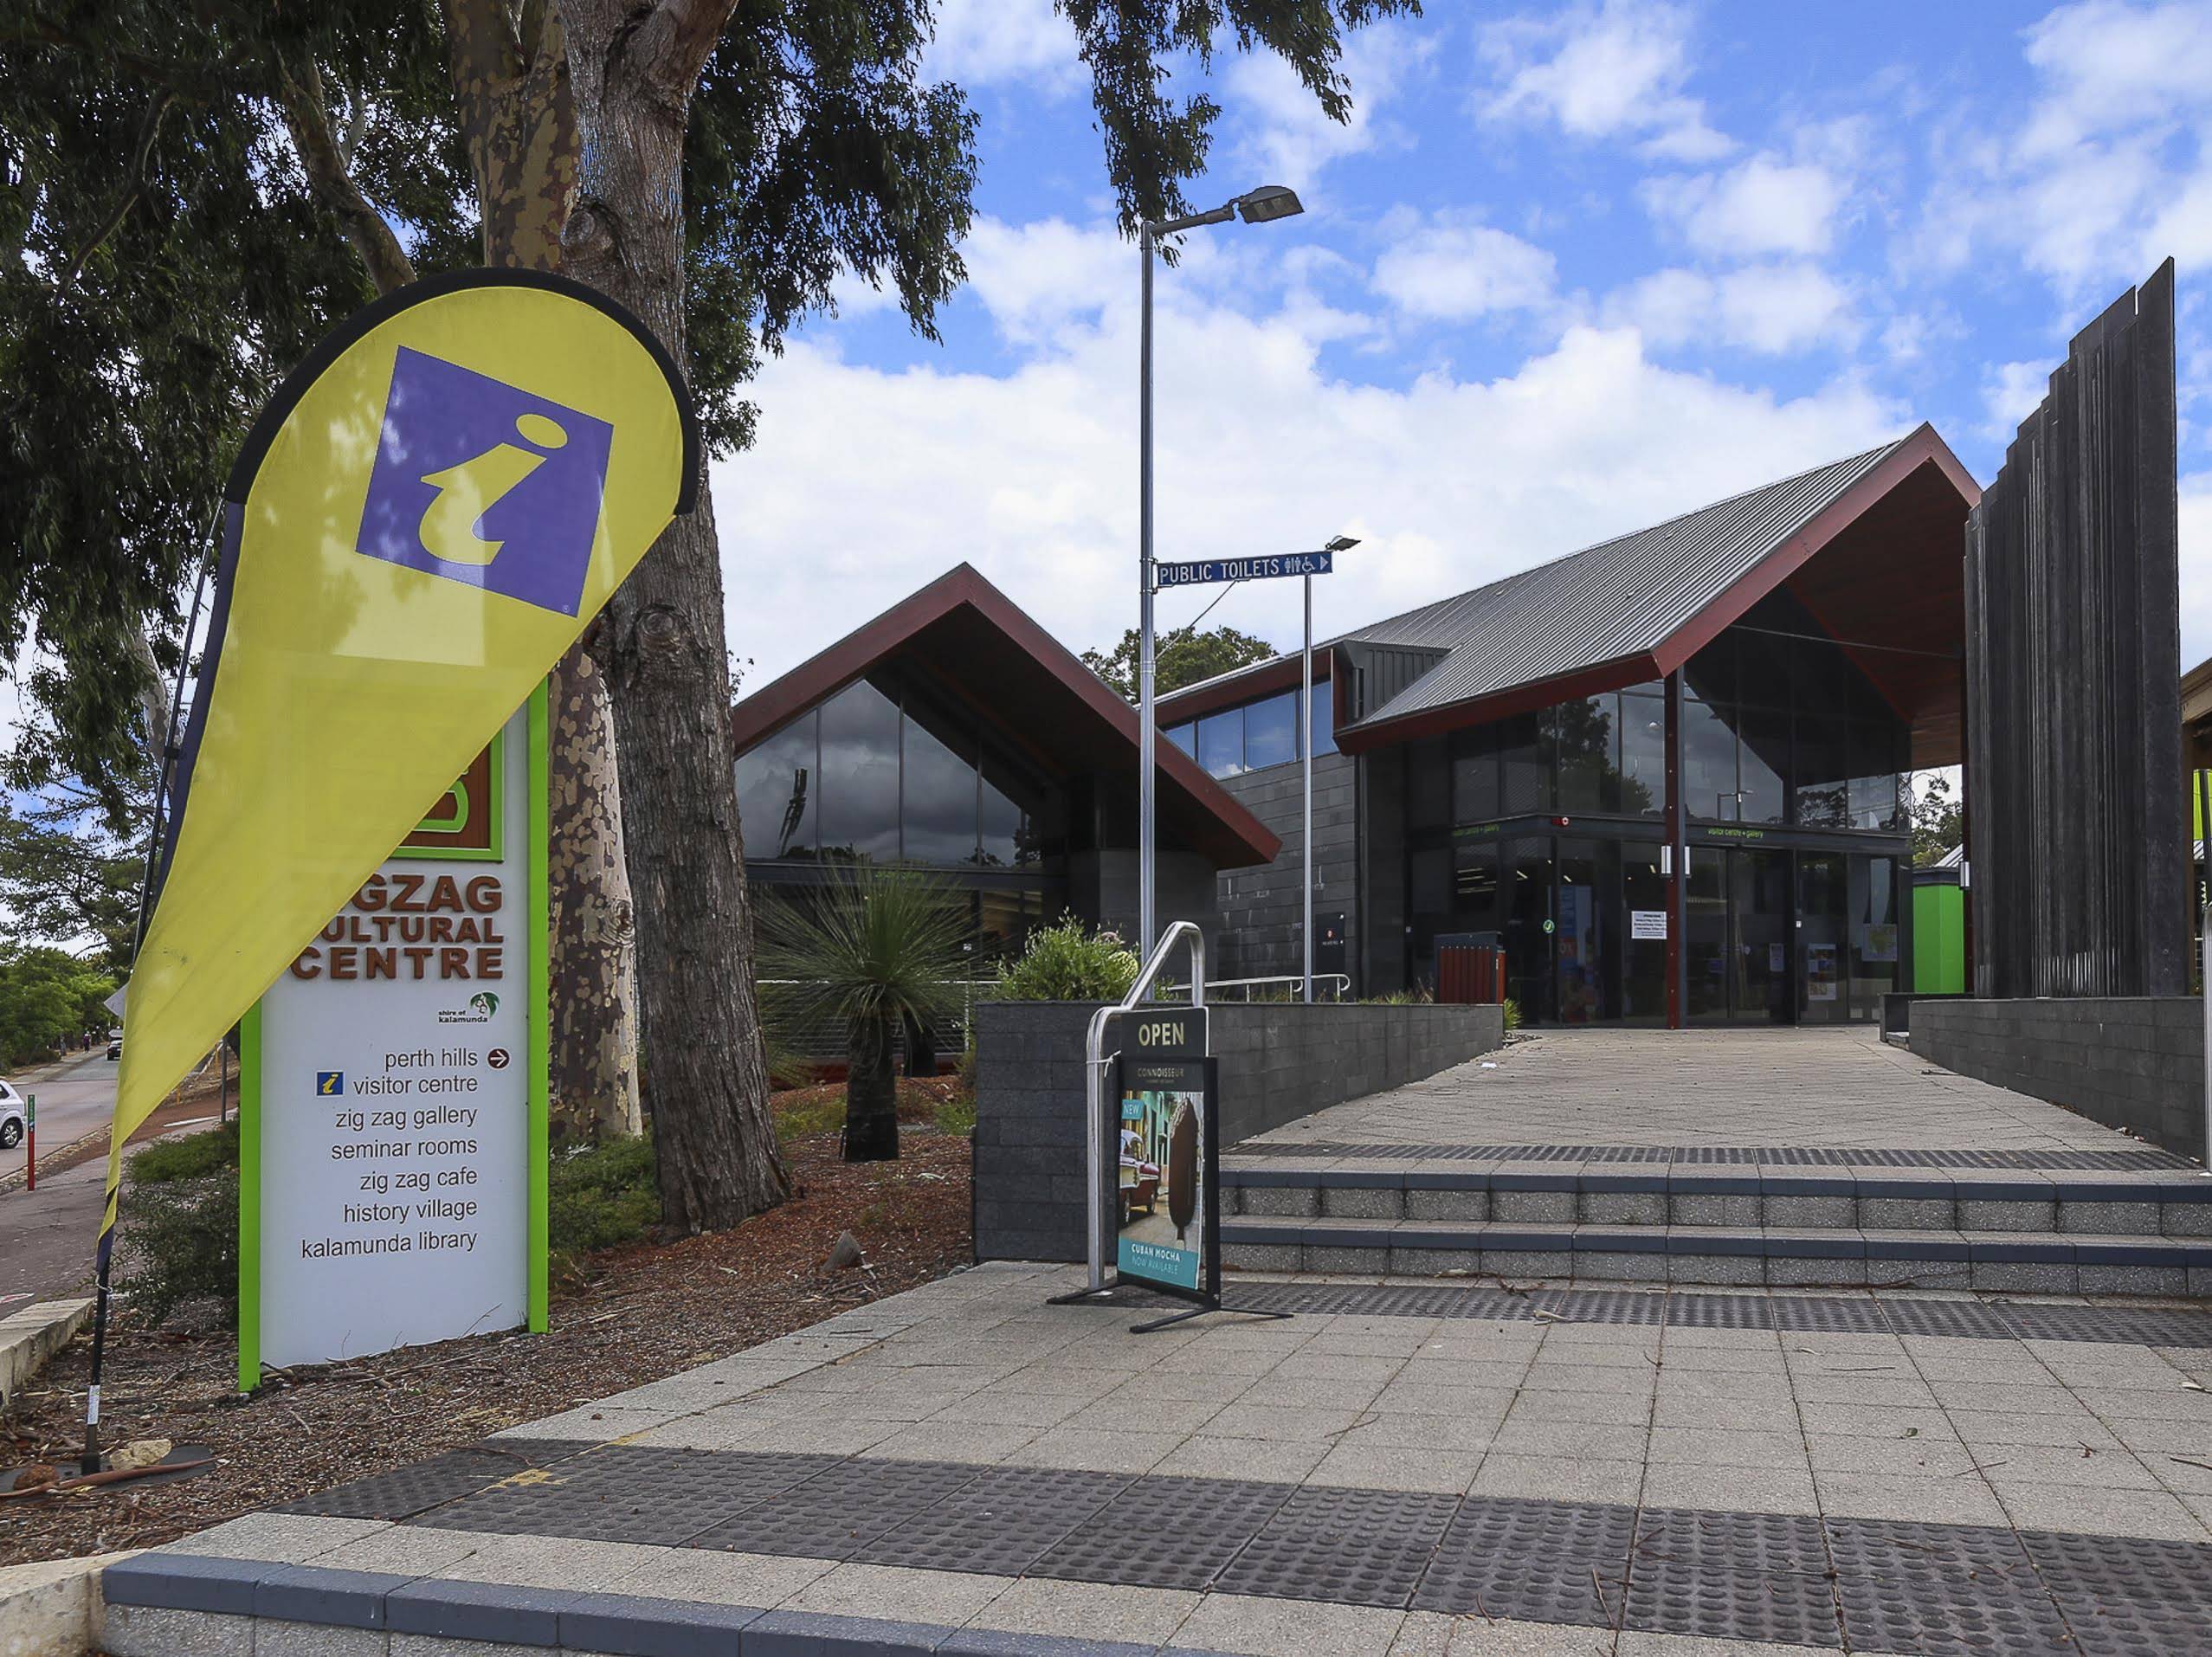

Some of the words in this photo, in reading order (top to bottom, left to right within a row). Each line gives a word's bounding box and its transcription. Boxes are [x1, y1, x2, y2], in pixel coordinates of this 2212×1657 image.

[1159, 564, 1212, 583] PUBLIC
[1220, 558, 1280, 578] TOILETS
[351, 874, 502, 912] GZAG
[320, 916, 504, 943] ULTURAL
[290, 946, 503, 979] CENTRE
[1138, 1022, 1185, 1047] OPEN
[385, 1049, 435, 1072] perth
[442, 1048, 478, 1067] hills
[353, 1076, 412, 1095] visitor
[418, 1074, 478, 1093] centre
[335, 1109, 364, 1132] zig
[371, 1111, 407, 1131] zag
[414, 1106, 478, 1129] gallery
[1123, 1104, 1140, 1115] NEW
[332, 1139, 412, 1159] seminar
[418, 1139, 478, 1156] rooms
[360, 1170, 389, 1194] zig
[395, 1171, 430, 1191] zag
[437, 1166, 478, 1186] cafe
[345, 1203, 410, 1224] history
[416, 1199, 478, 1220] village
[302, 1234, 411, 1258] kalamunda
[419, 1231, 478, 1251] library
[1132, 1243, 1154, 1257] CUBAN
[1155, 1248, 1181, 1262] MOCHA
